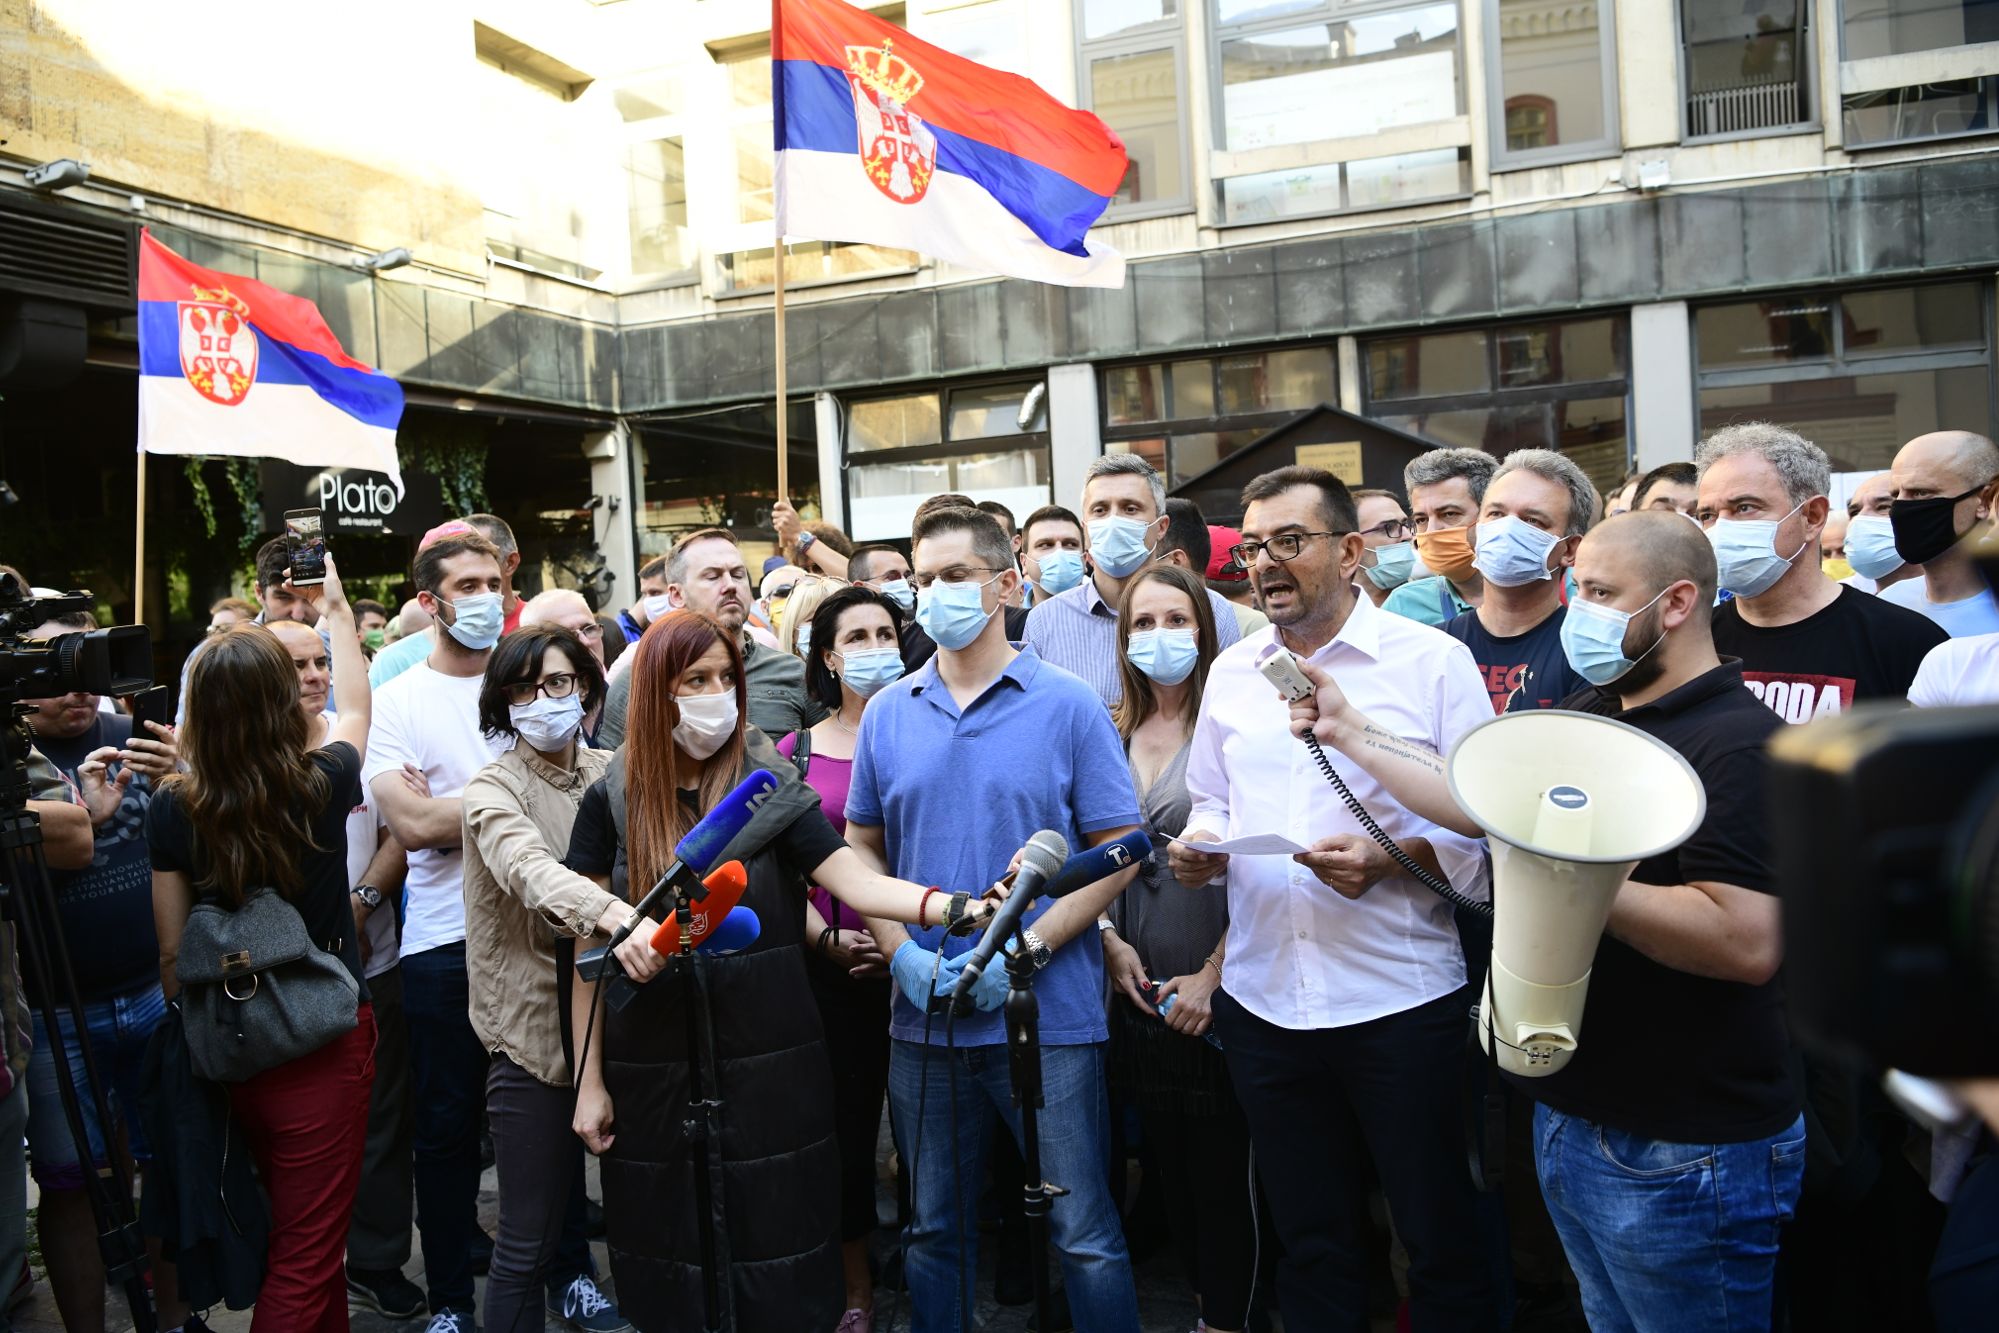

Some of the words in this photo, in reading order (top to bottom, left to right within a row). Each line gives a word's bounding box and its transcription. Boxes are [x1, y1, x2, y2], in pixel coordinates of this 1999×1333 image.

[319, 473, 396, 514] Plato
[353, 518, 383, 527] restaurant
[78, 875, 125, 892] ITALIAN
[80, 886, 115, 901] YOUR
[118, 878, 142, 891] BEST
